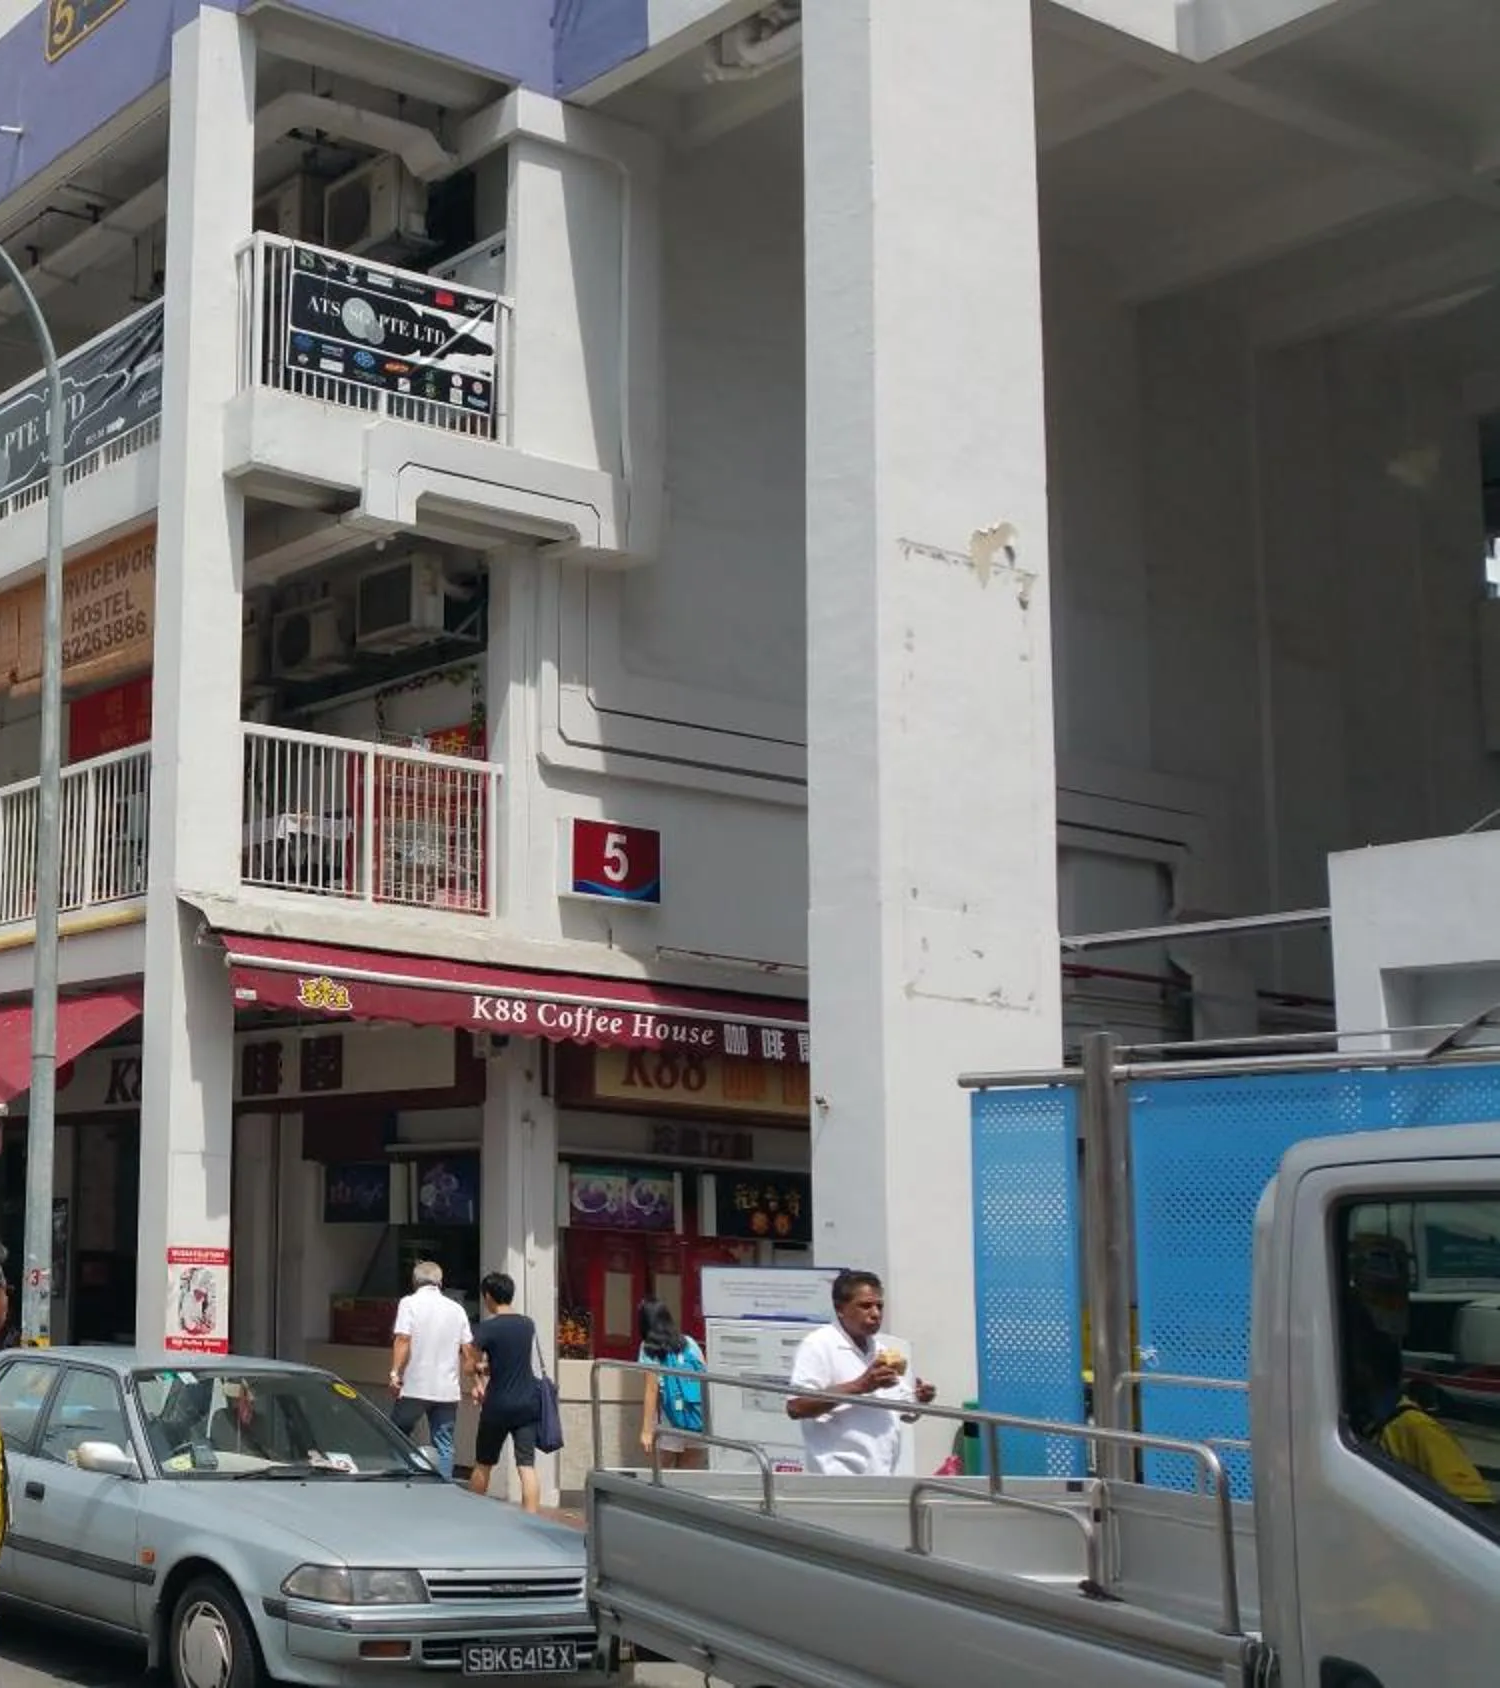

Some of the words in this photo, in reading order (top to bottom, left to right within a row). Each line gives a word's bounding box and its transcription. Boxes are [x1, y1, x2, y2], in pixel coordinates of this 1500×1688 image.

[308, 296, 341, 317] ATS
[379, 314, 410, 338] PTE
[413, 325, 447, 346] LTD
[4, 416, 40, 458] PTE
[45, 391, 86, 438] LD
[71, 589, 135, 634] HOSTEL
[603, 832, 629, 882] 5
[472, 996, 527, 1023] K88
[538, 1003, 623, 1038] Coffee
[633, 1013, 715, 1046] House
